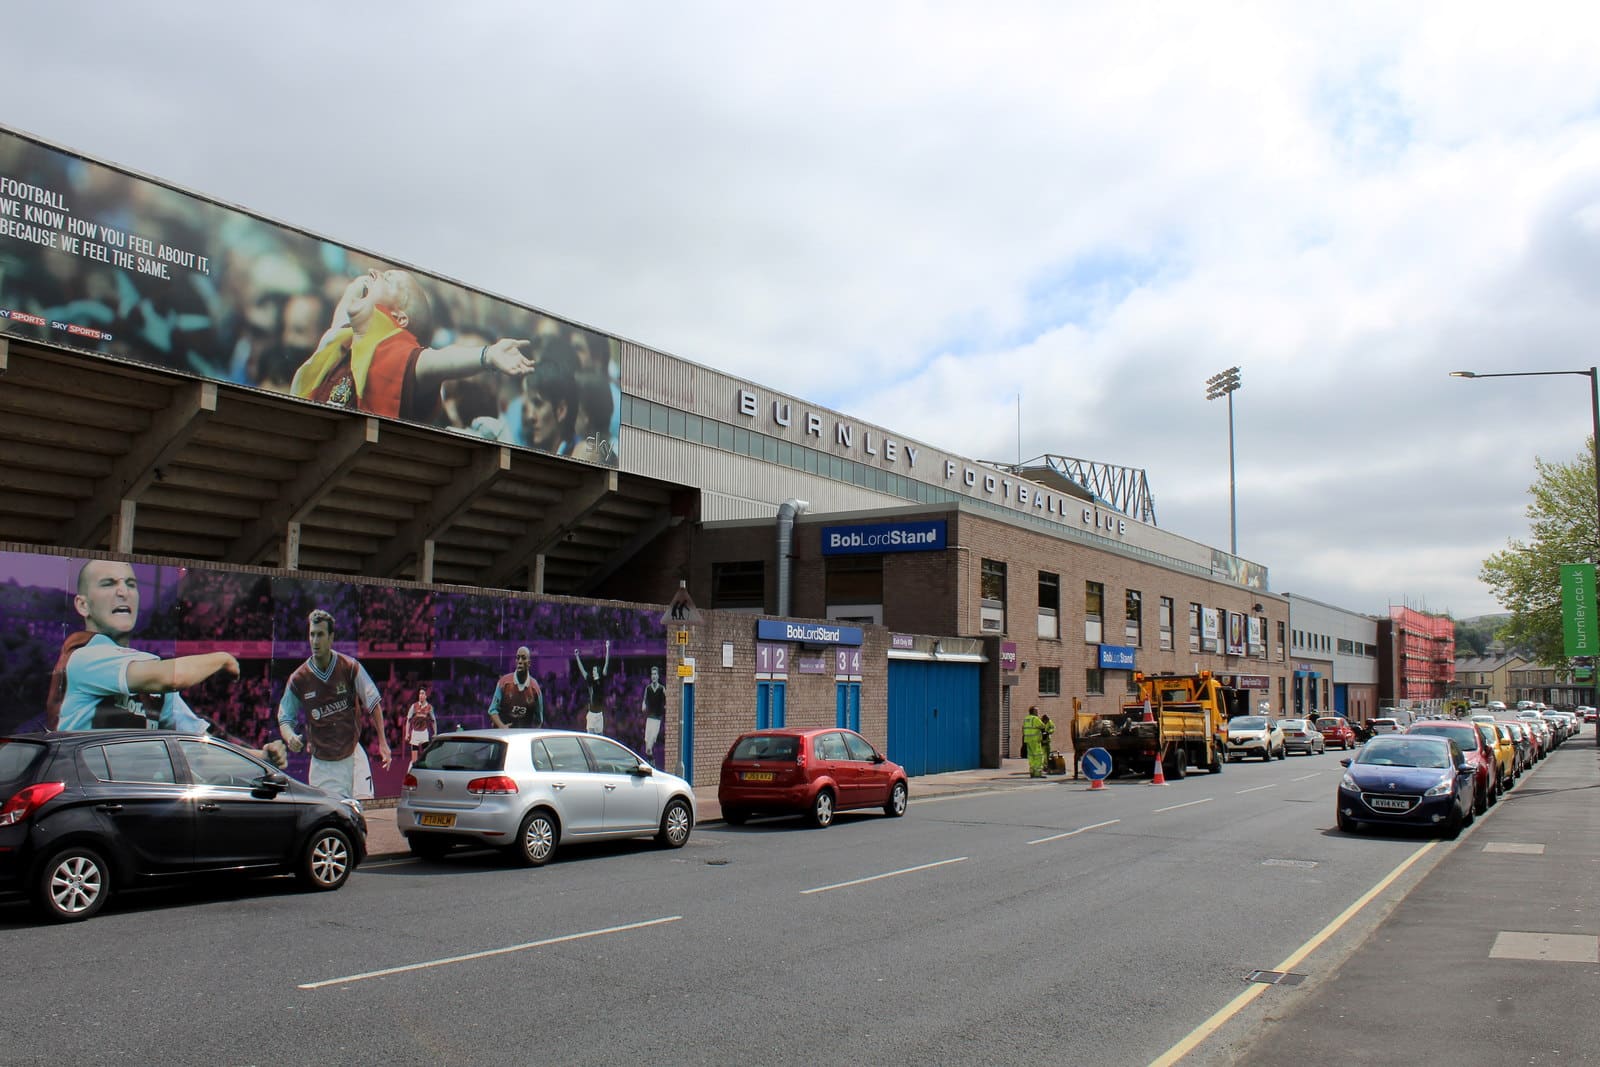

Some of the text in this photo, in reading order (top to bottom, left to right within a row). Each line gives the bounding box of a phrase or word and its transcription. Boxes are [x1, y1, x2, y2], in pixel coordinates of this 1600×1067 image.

[1, 177, 70, 212] FOOTBALL.
[0, 197, 20, 217] WE
[25, 205, 64, 229] KNOW
[68, 217, 96, 239] HOW
[100, 226, 125, 247] YOU
[129, 235, 154, 257] FEEL
[158, 245, 195, 268] ABOUT
[0, 219, 170, 280] BECAUSE WE FEEL THE SAME.
[12, 312, 46, 326] SPORTS
[51, 321, 112, 341] SKY SPORTS HD
[738, 389, 1127, 535] BURNLEY FOOTBALL CLUB
[830, 529, 936, 548] BobLordStand
[1572, 570, 1587, 649] burnley.co.uk
[678, 632, 687, 644] H
[786, 625, 839, 642] BobLordStand
[761, 647, 785, 669] 1 2
[839, 651, 860, 671] 3 4
[1103, 651, 1133, 664] BobLStand
